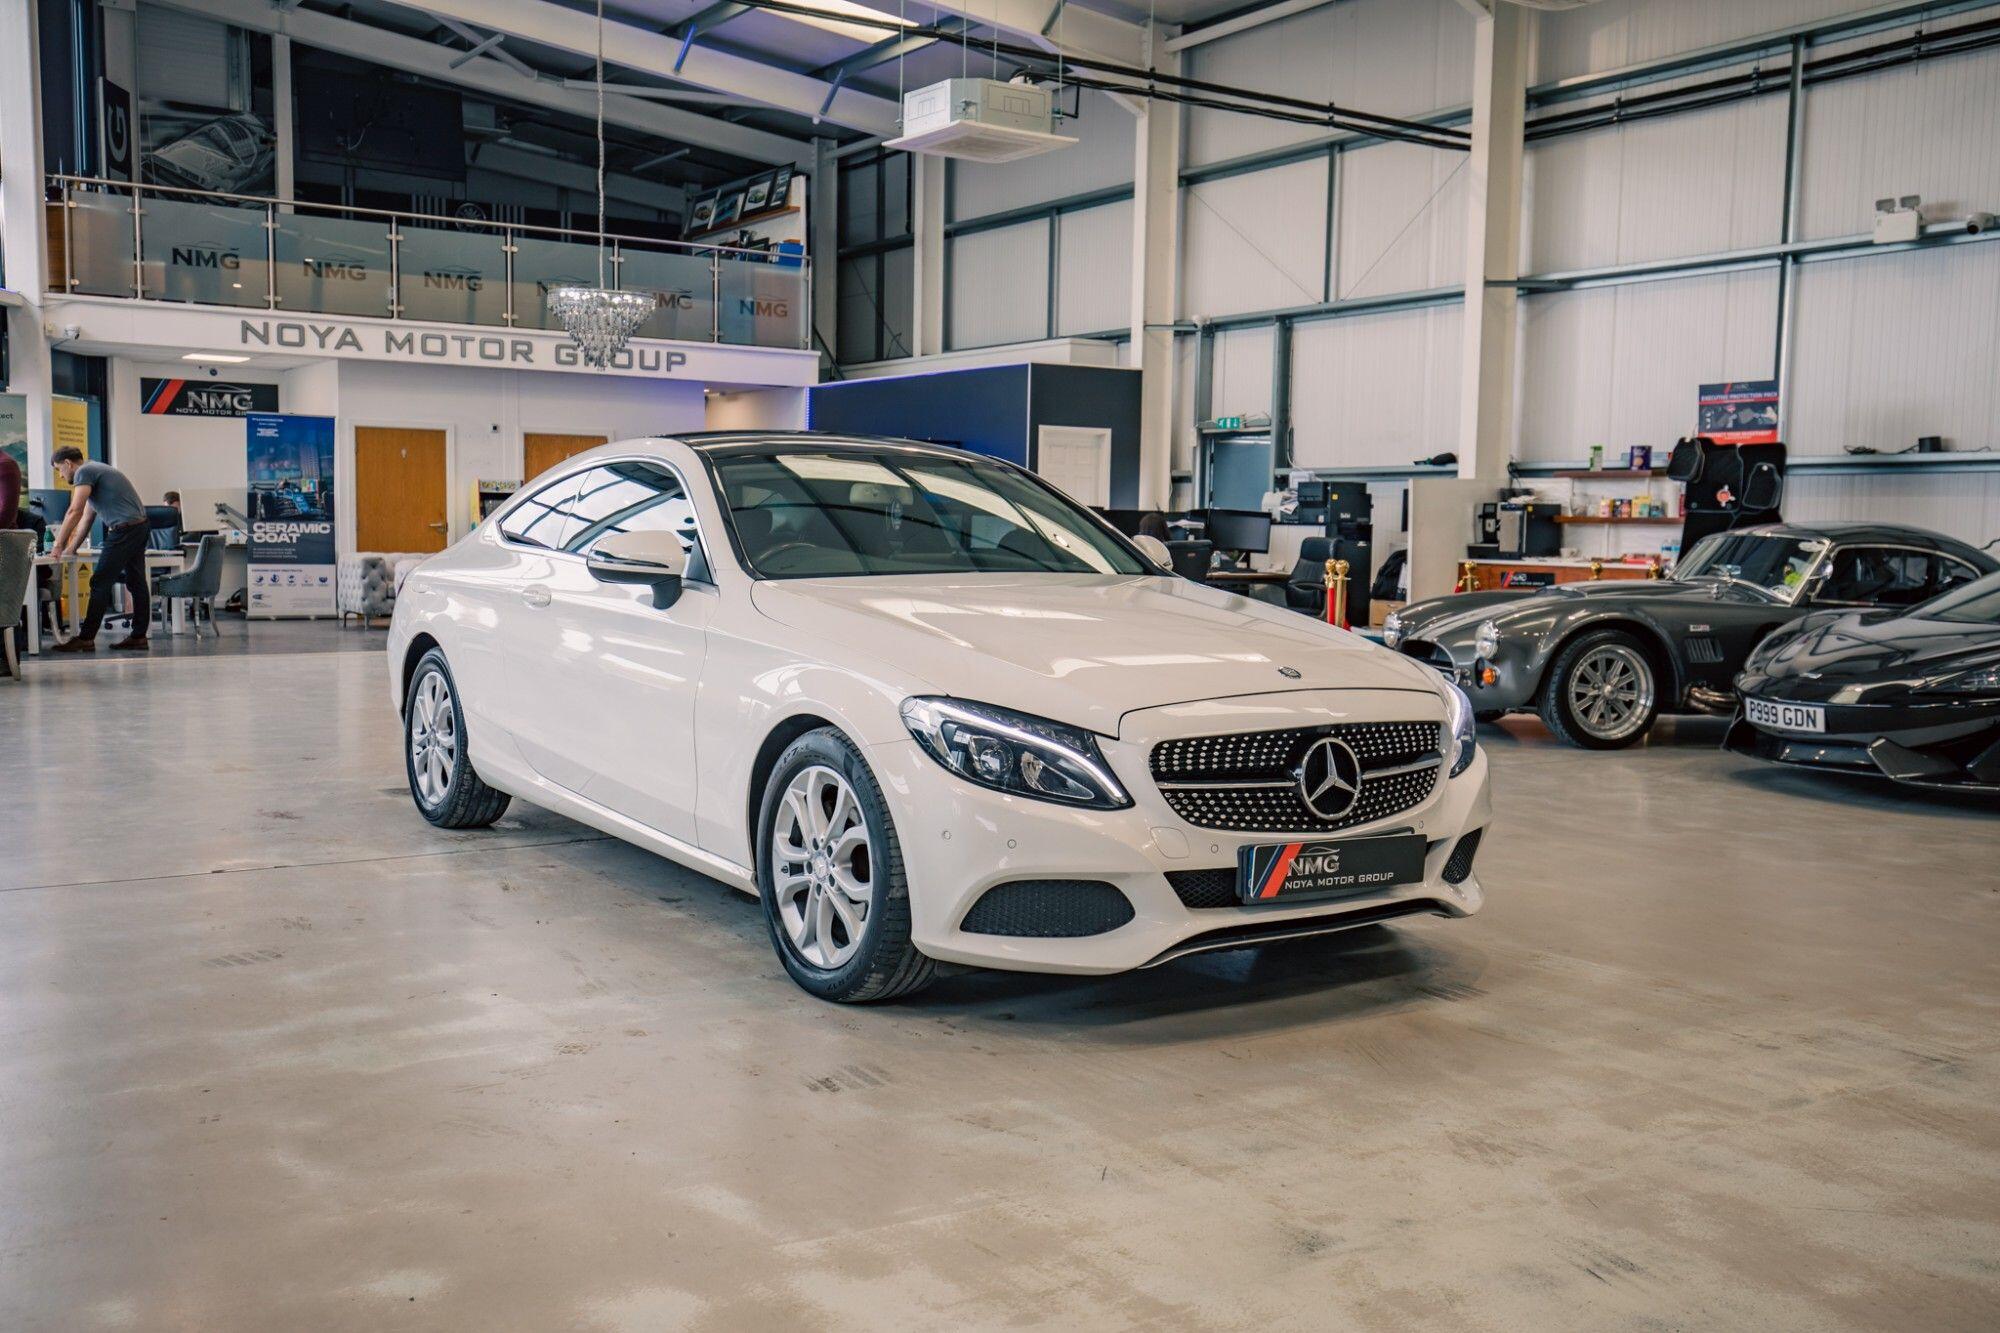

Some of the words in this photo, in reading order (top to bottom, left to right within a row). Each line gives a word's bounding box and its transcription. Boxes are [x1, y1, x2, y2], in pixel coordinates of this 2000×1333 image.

[172, 248, 240, 270] NMG
[303, 260, 366, 281] NMG
[424, 271, 482, 292] NMG
[739, 298, 788, 318] NMG
[241, 320, 363, 351] NOYA
[385, 330, 533, 364] MOTOR
[187, 391, 253, 410] NMG
[202, 408, 231, 416] MOTOR
[253, 522, 331, 534] CERAMIC
[253, 532, 300, 543] COAT
[1749, 701, 1778, 723] P999
[1783, 707, 1817, 728] GDN
[1287, 855, 1340, 877] NMG
[1285, 880, 1313, 889] NOYA
[1317, 875, 1354, 886] MOTOR
[1358, 872, 1394, 883] GROUP
